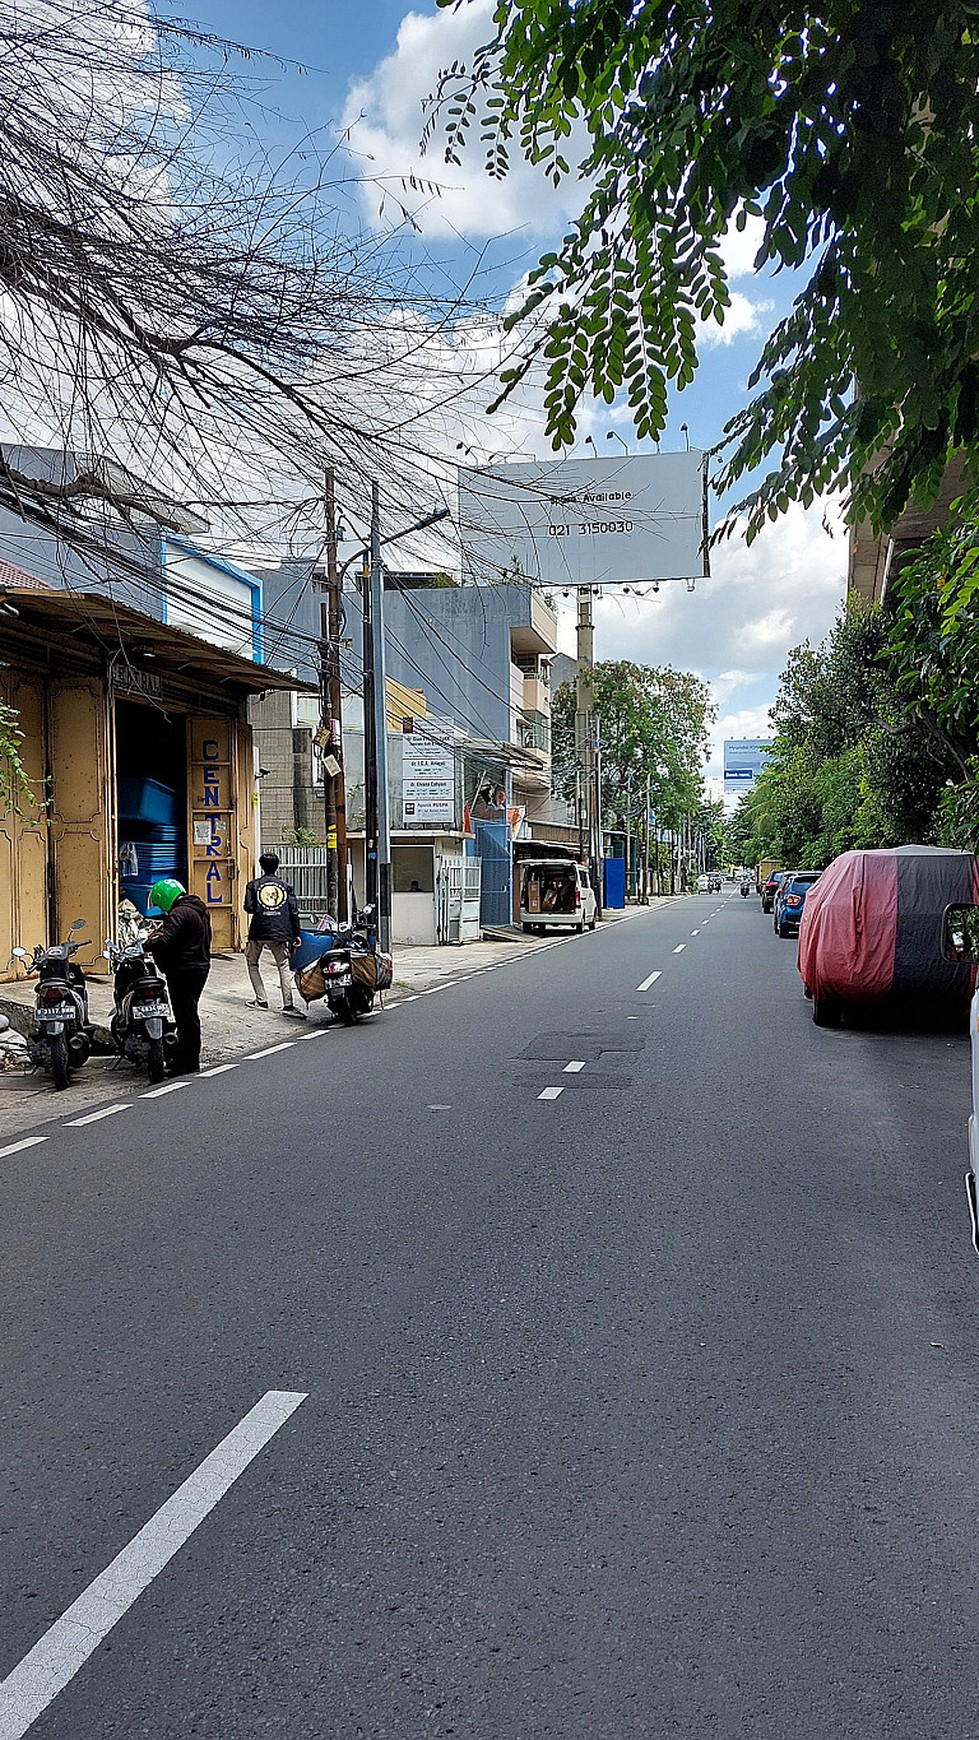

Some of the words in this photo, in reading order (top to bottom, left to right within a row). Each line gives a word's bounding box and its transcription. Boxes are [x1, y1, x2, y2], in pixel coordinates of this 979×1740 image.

[583, 491, 632, 502] Available
[549, 524, 570, 536] 021
[578, 521, 633, 535] 3150030
[202, 739, 223, 903] CENTRAL
